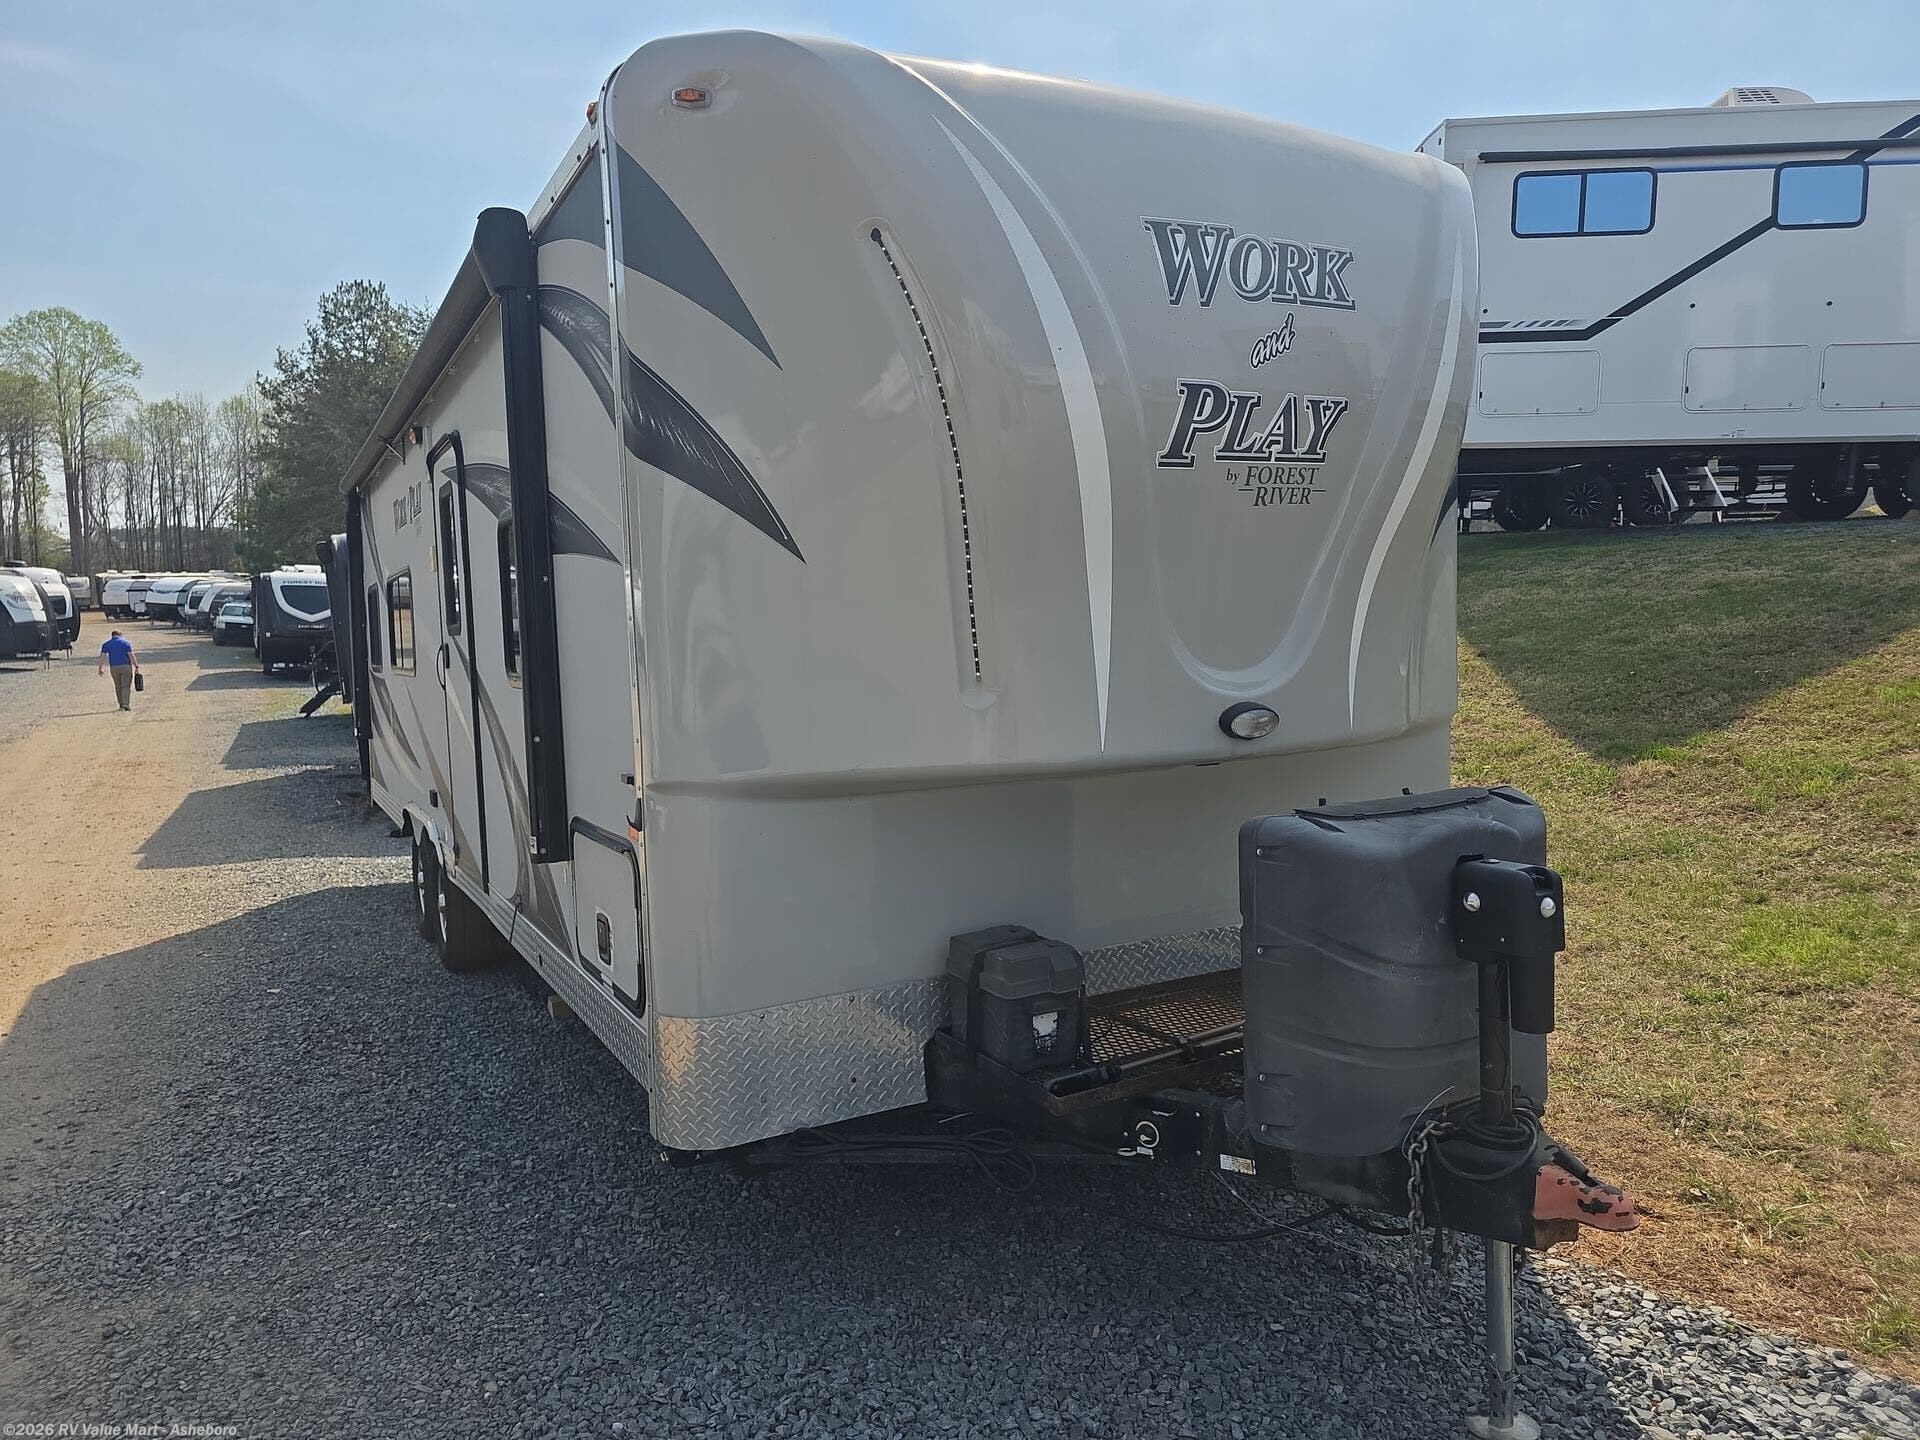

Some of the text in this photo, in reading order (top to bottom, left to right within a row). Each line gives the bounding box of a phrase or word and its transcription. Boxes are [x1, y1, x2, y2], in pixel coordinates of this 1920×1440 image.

[1140, 216, 1357, 311] WORK
[1250, 311, 1296, 370] and
[1156, 378, 1349, 469] PLAY
[1226, 465, 1319, 486] by FOREST
[1252, 486, 1312, 507] RIVER
